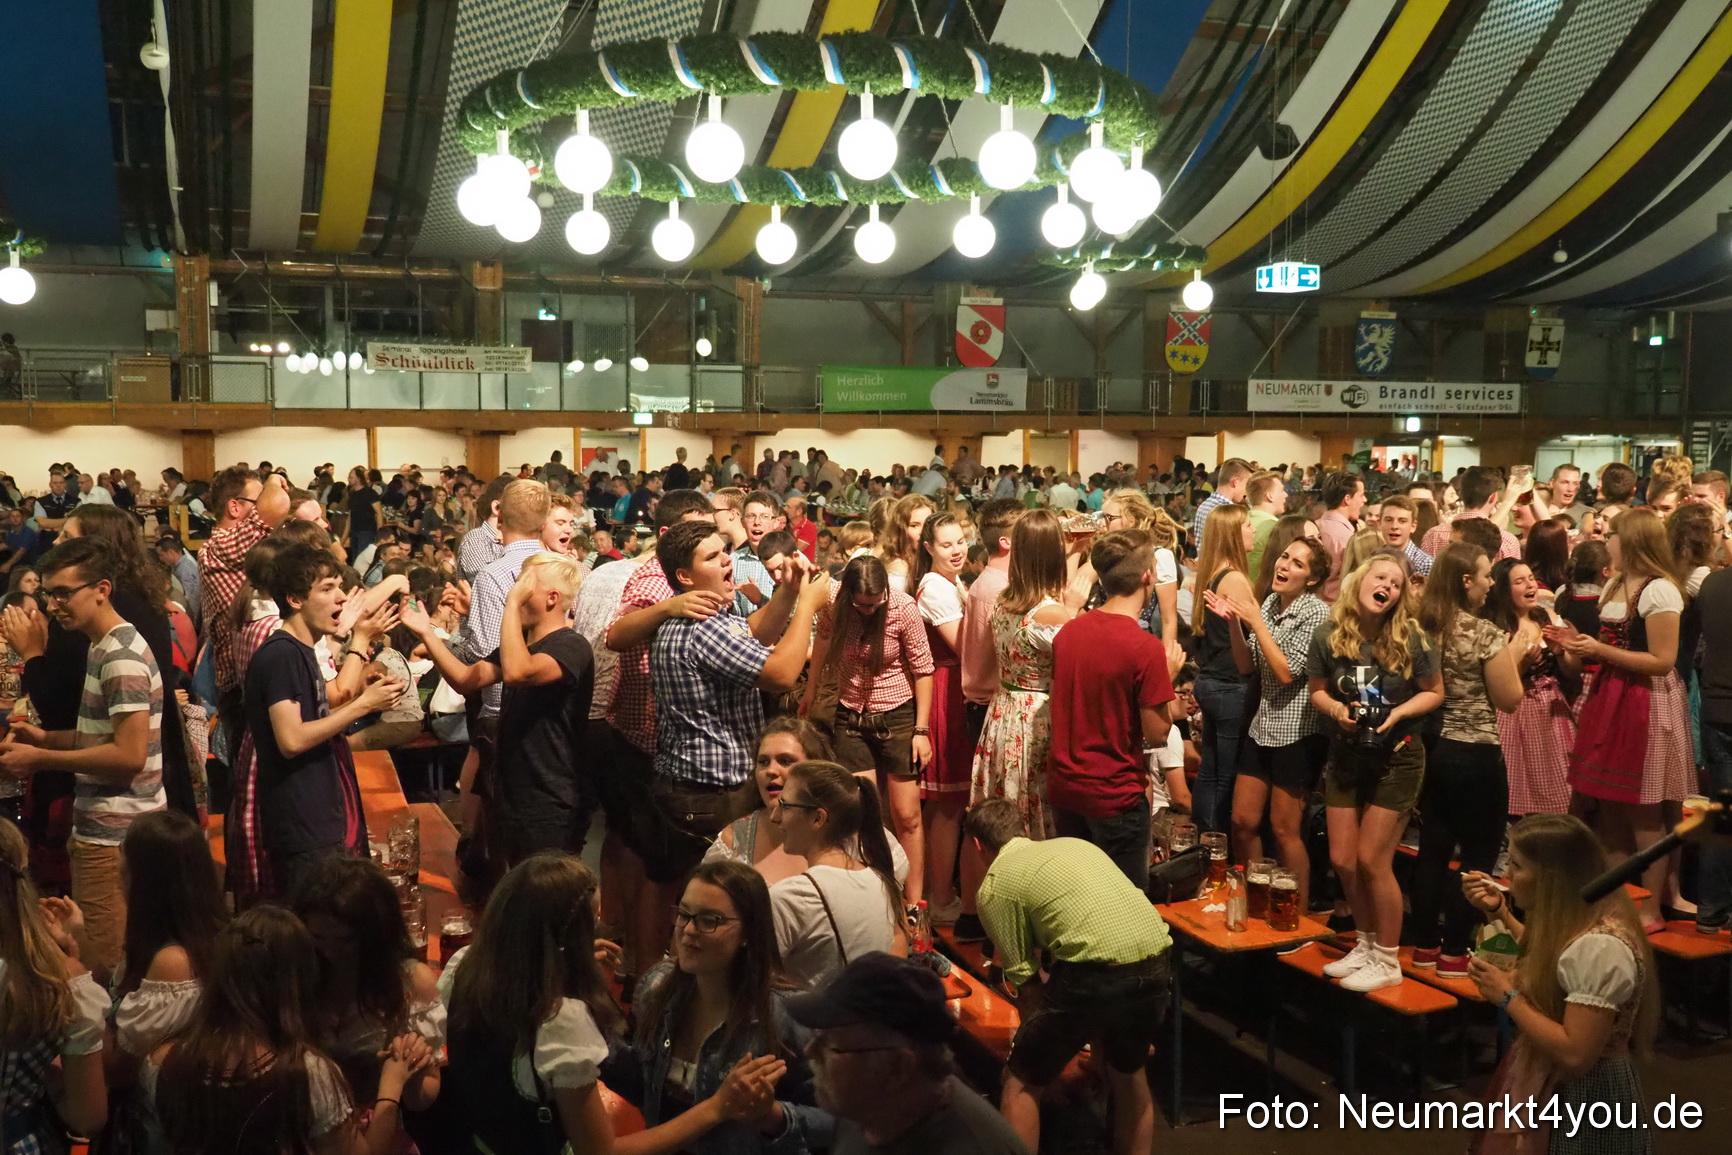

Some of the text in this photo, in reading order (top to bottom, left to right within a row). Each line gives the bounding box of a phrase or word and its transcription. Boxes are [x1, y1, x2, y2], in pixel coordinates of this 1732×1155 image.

[837, 373, 884, 387] Herzlich
[837, 390, 907, 402] Willkommen
[1256, 382, 1321, 396] NEUMARKT
[1379, 385, 1513, 400] Brandl services
